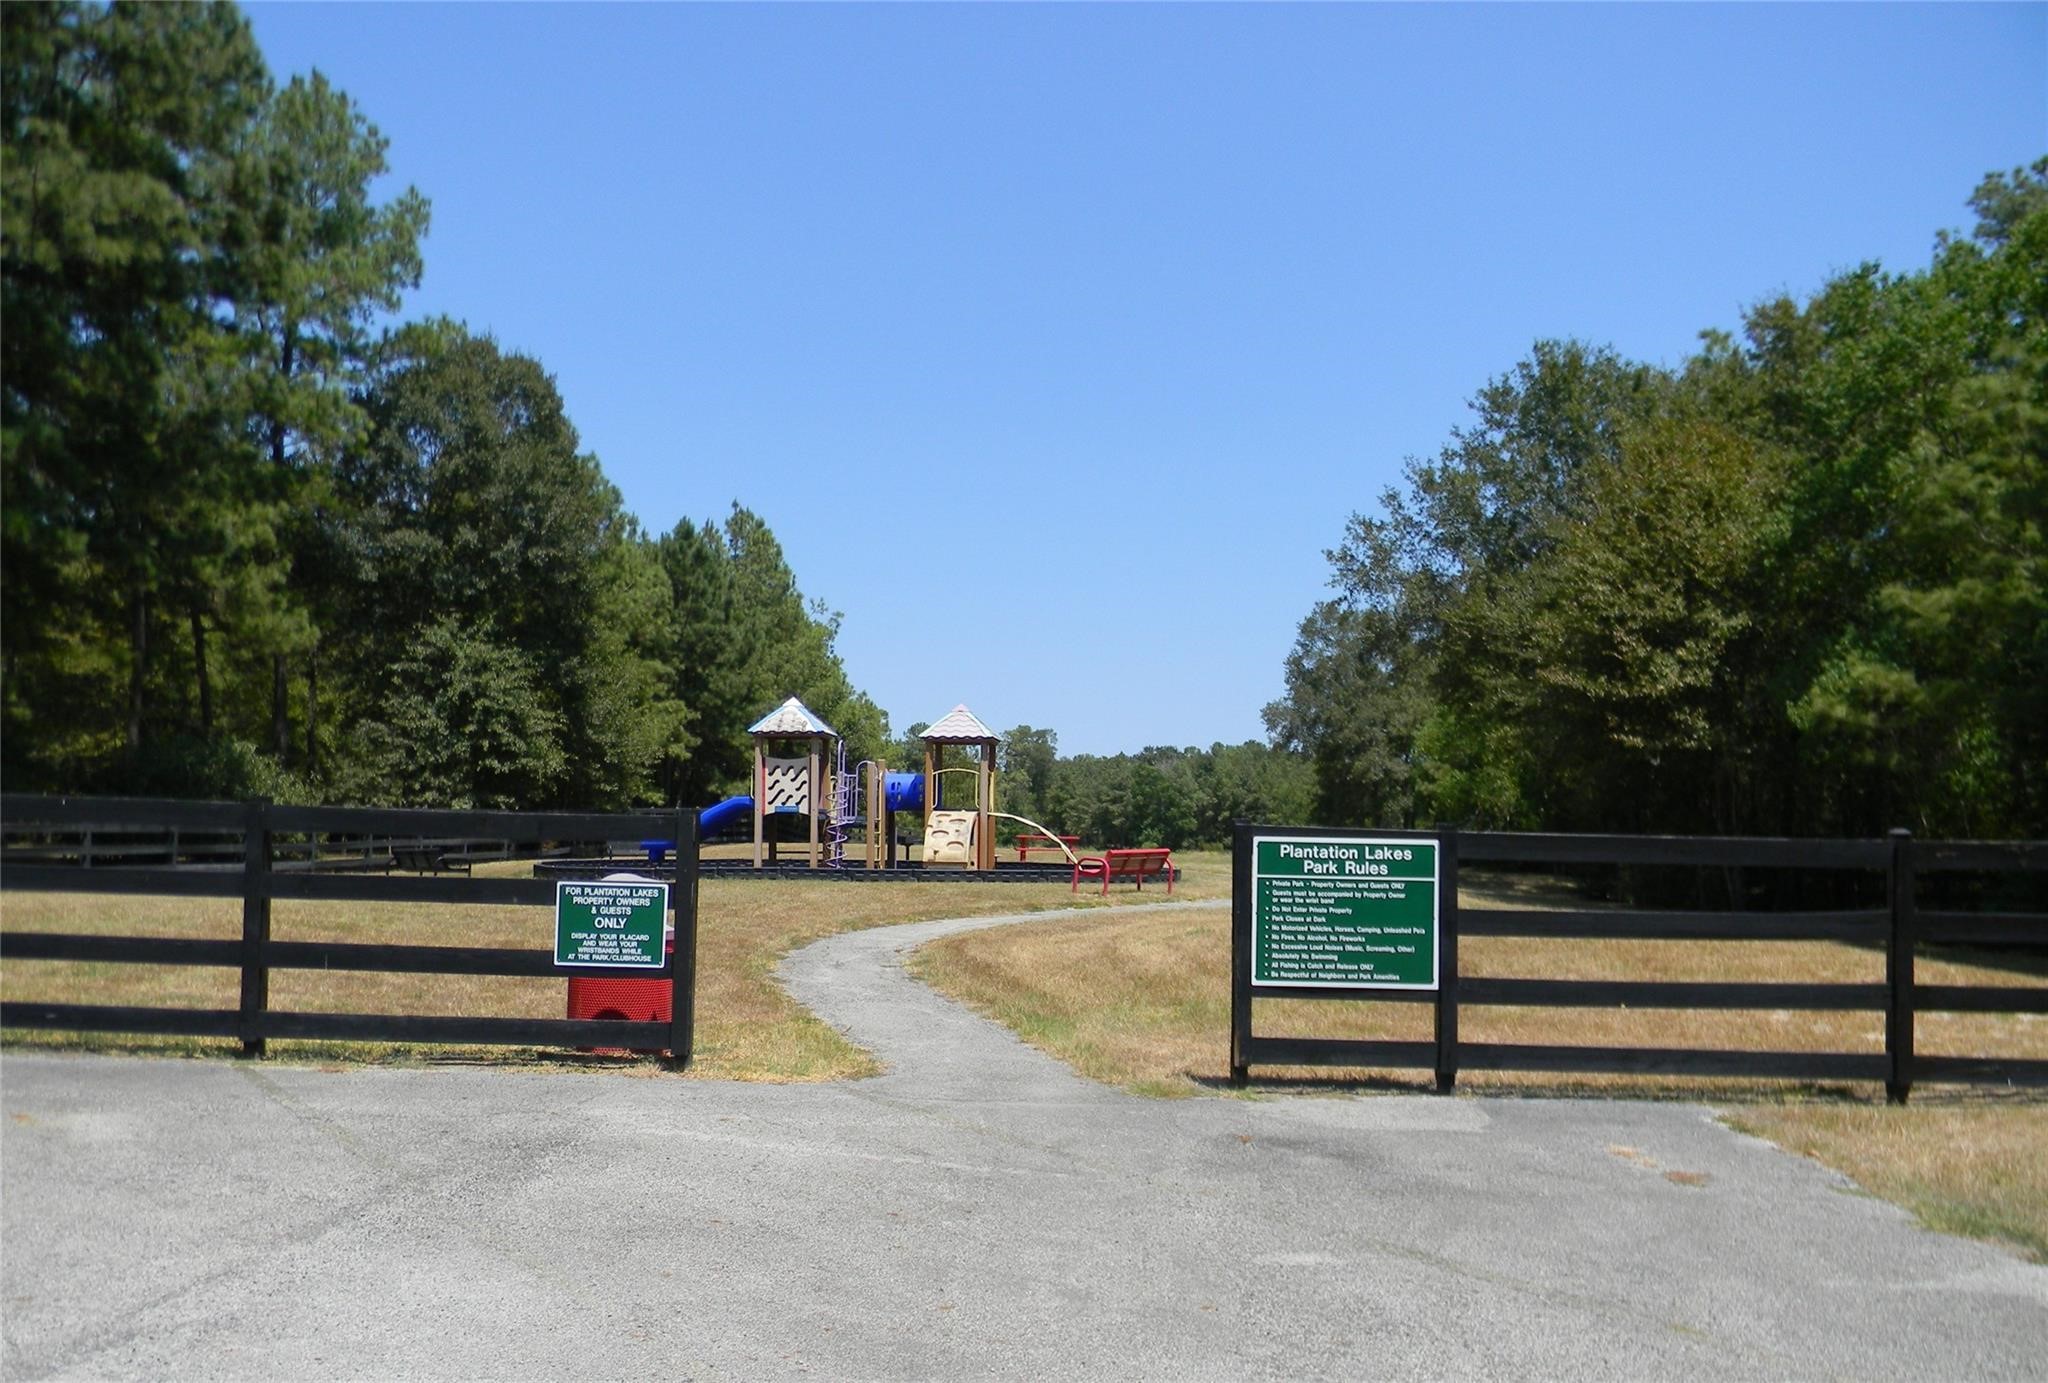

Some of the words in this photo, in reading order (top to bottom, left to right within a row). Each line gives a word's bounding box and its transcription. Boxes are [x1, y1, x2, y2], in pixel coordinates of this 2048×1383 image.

[1280, 844, 1358, 860] Plantation
[1365, 846, 1412, 860] Lakes
[1304, 861, 1337, 874] Park
[1345, 861, 1388, 875] Rules
[566, 887, 581, 895] FOR
[584, 888, 630, 896] PLANTATION
[633, 888, 658, 897] LAKES
[573, 896, 614, 905] PROPERTY
[616, 898, 650, 906] OWNERS
[600, 906, 632, 915] GUESTS
[1329, 907, 1352, 915] Property
[594, 917, 627, 928] ONLY
